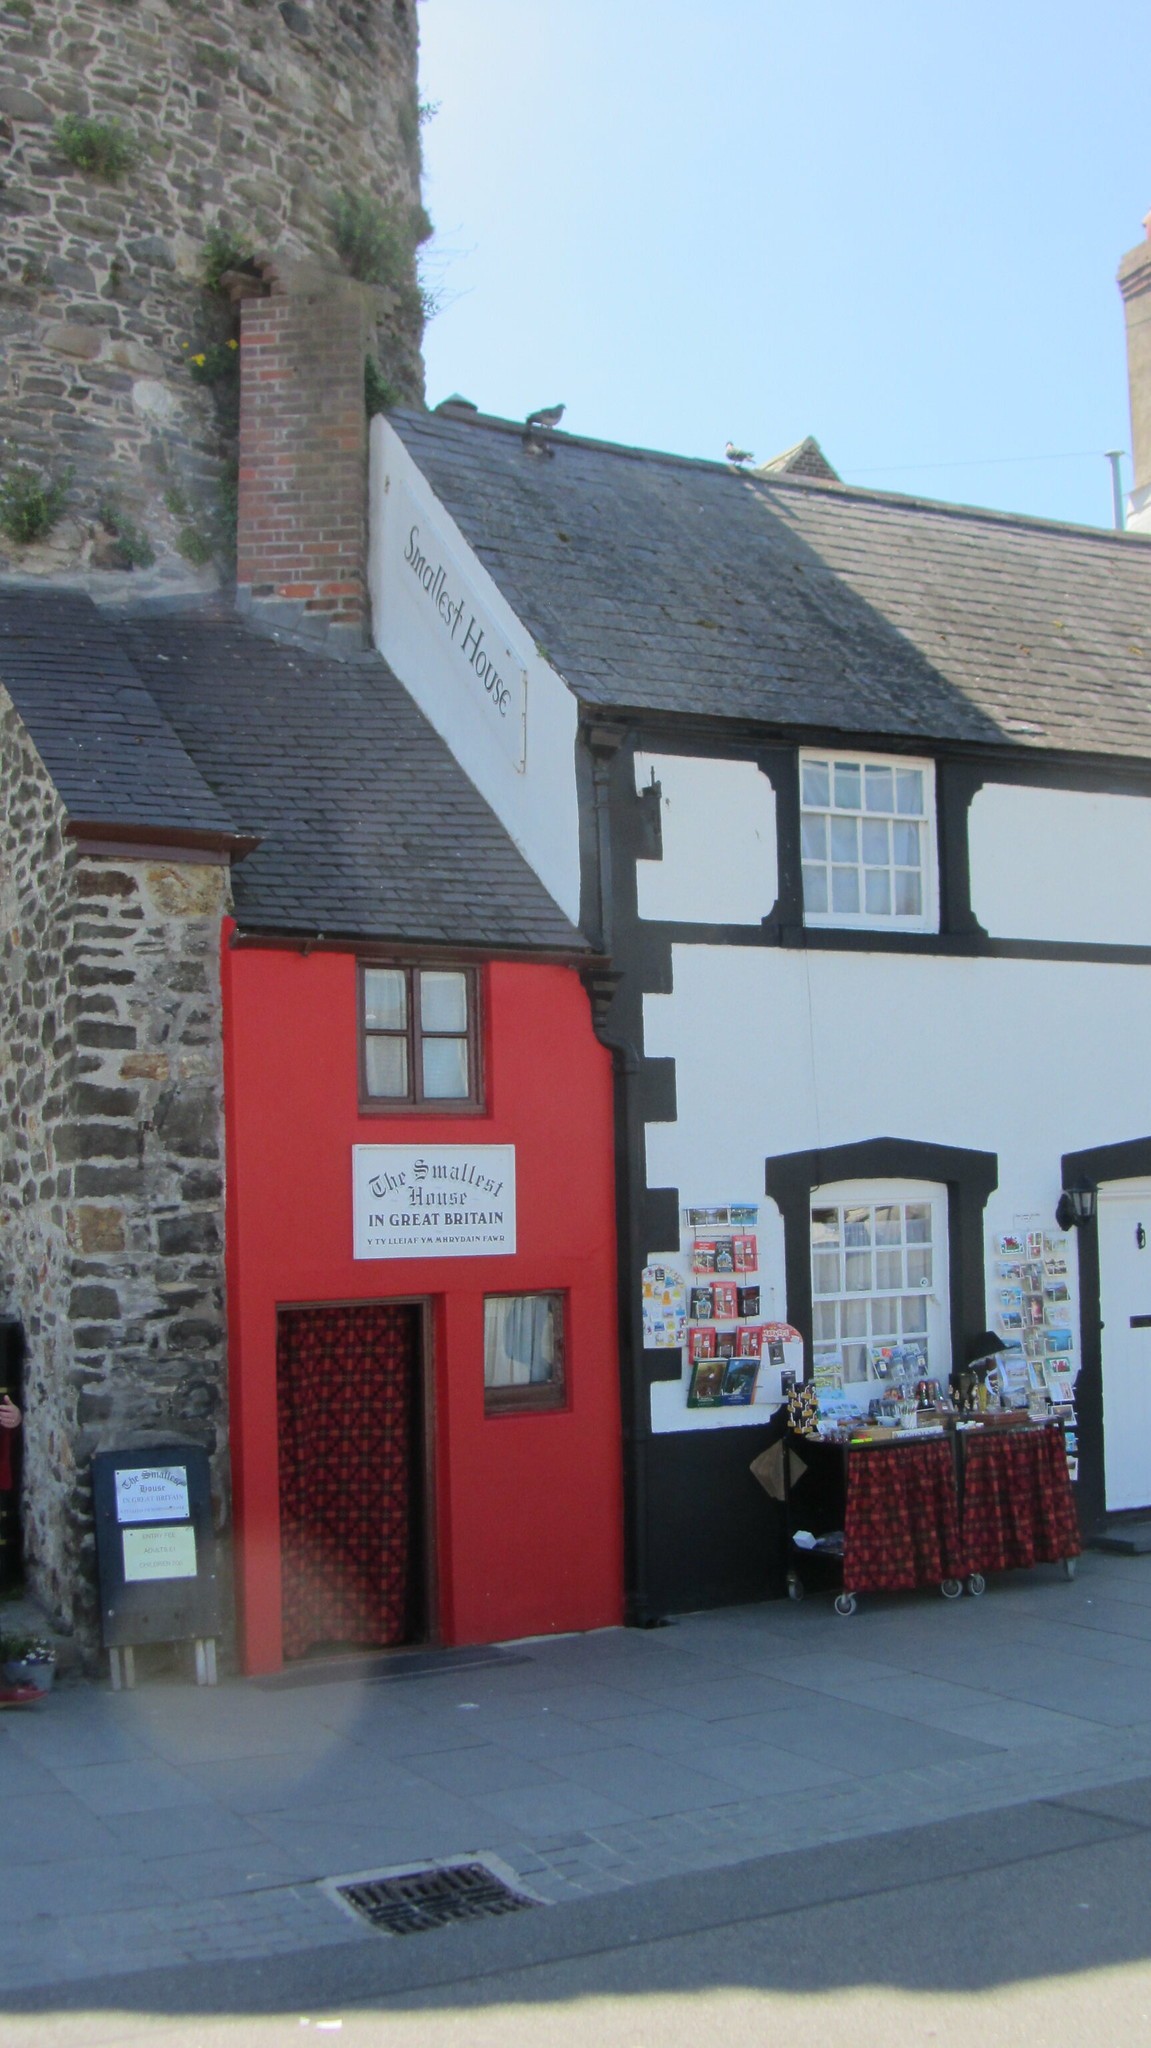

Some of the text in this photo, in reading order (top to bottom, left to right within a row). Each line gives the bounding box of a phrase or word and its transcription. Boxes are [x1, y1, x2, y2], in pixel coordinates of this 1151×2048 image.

[403, 524, 512, 718] Smallest House
[368, 1158, 504, 1199] The Smallest
[409, 1185, 468, 1207] House
[368, 1211, 504, 1227] IN GREAT BRITAIN
[367, 1238, 373, 1246] Y
[388, 1236, 419, 1245] LLEIAF
[421, 1236, 434, 1244] YM
[435, 1235, 481, 1244] MHRYDAIN
[482, 1234, 505, 1243] FAWR
[121, 1475, 139, 1490] The
[155, 1494, 184, 1502] BRITAIN
